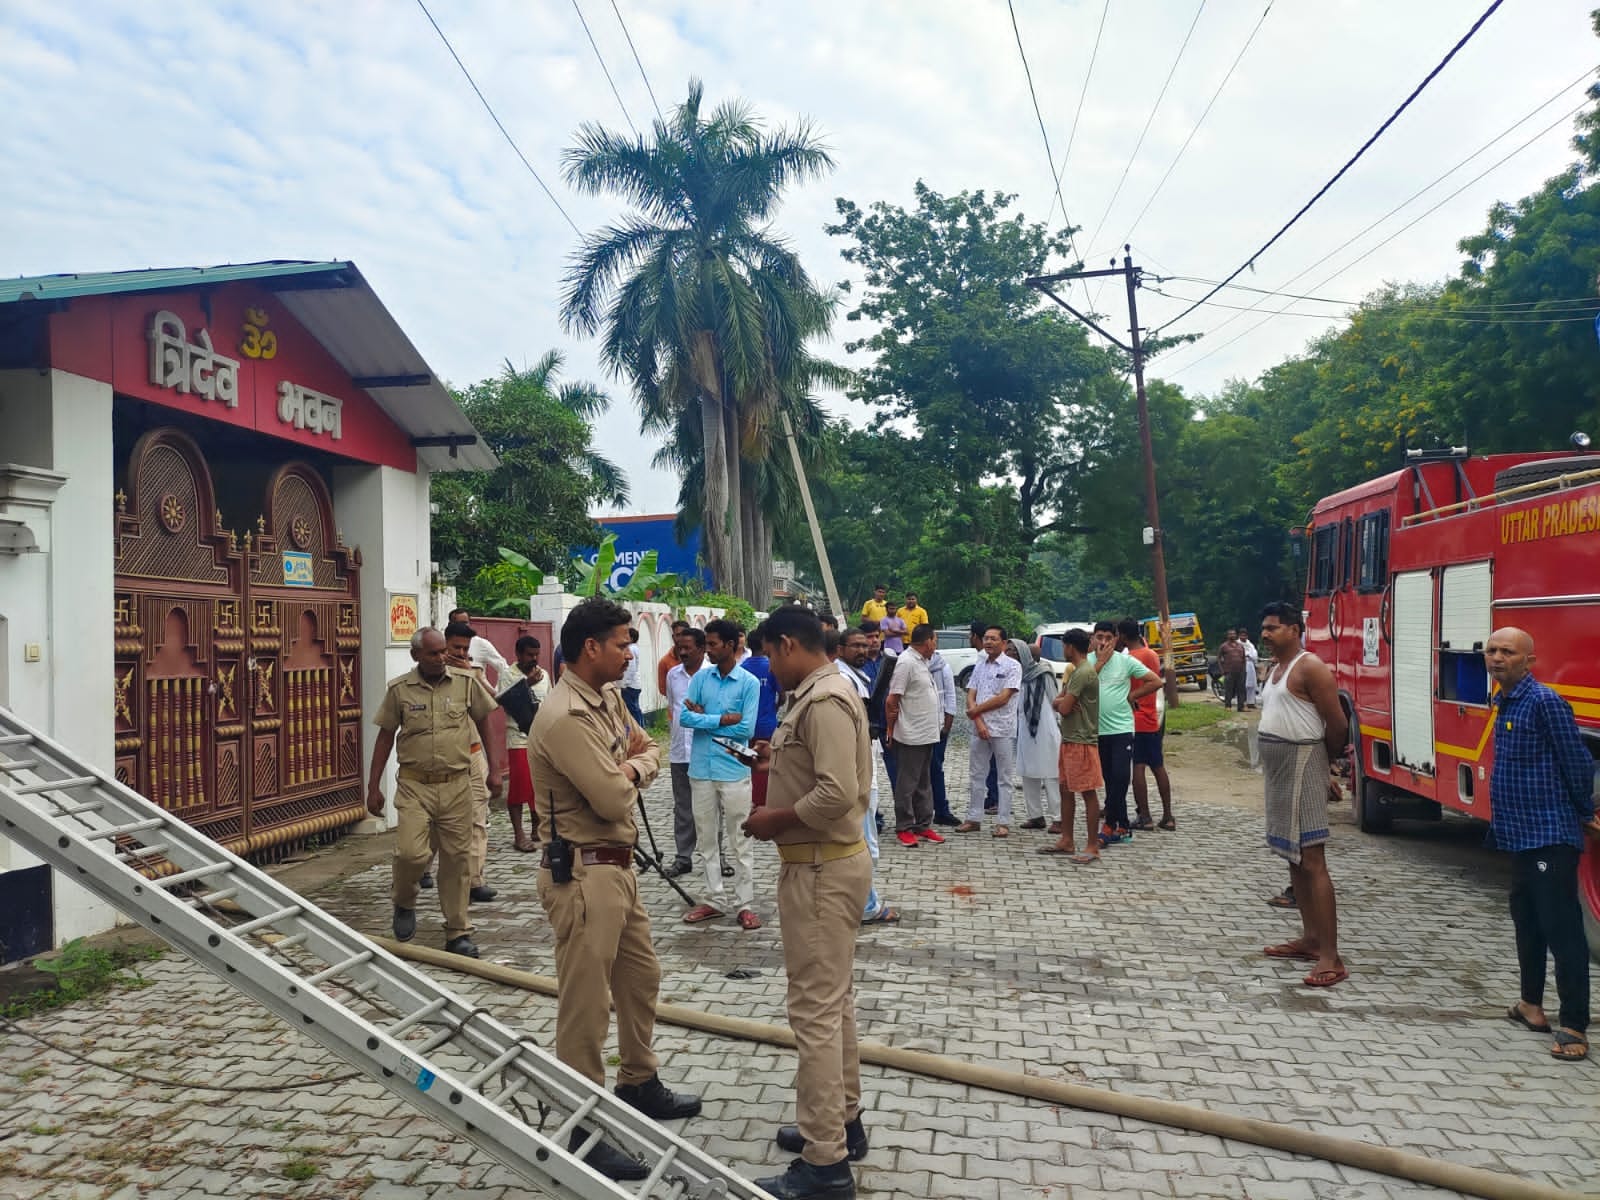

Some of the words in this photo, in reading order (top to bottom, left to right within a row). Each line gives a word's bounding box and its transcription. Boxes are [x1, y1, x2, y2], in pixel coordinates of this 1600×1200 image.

[152, 310, 240, 408] त्रिदेव
[278, 380, 343, 439] भवन
[1501, 507, 1539, 545] UTTAR
[590, 550, 649, 567] CMEN
